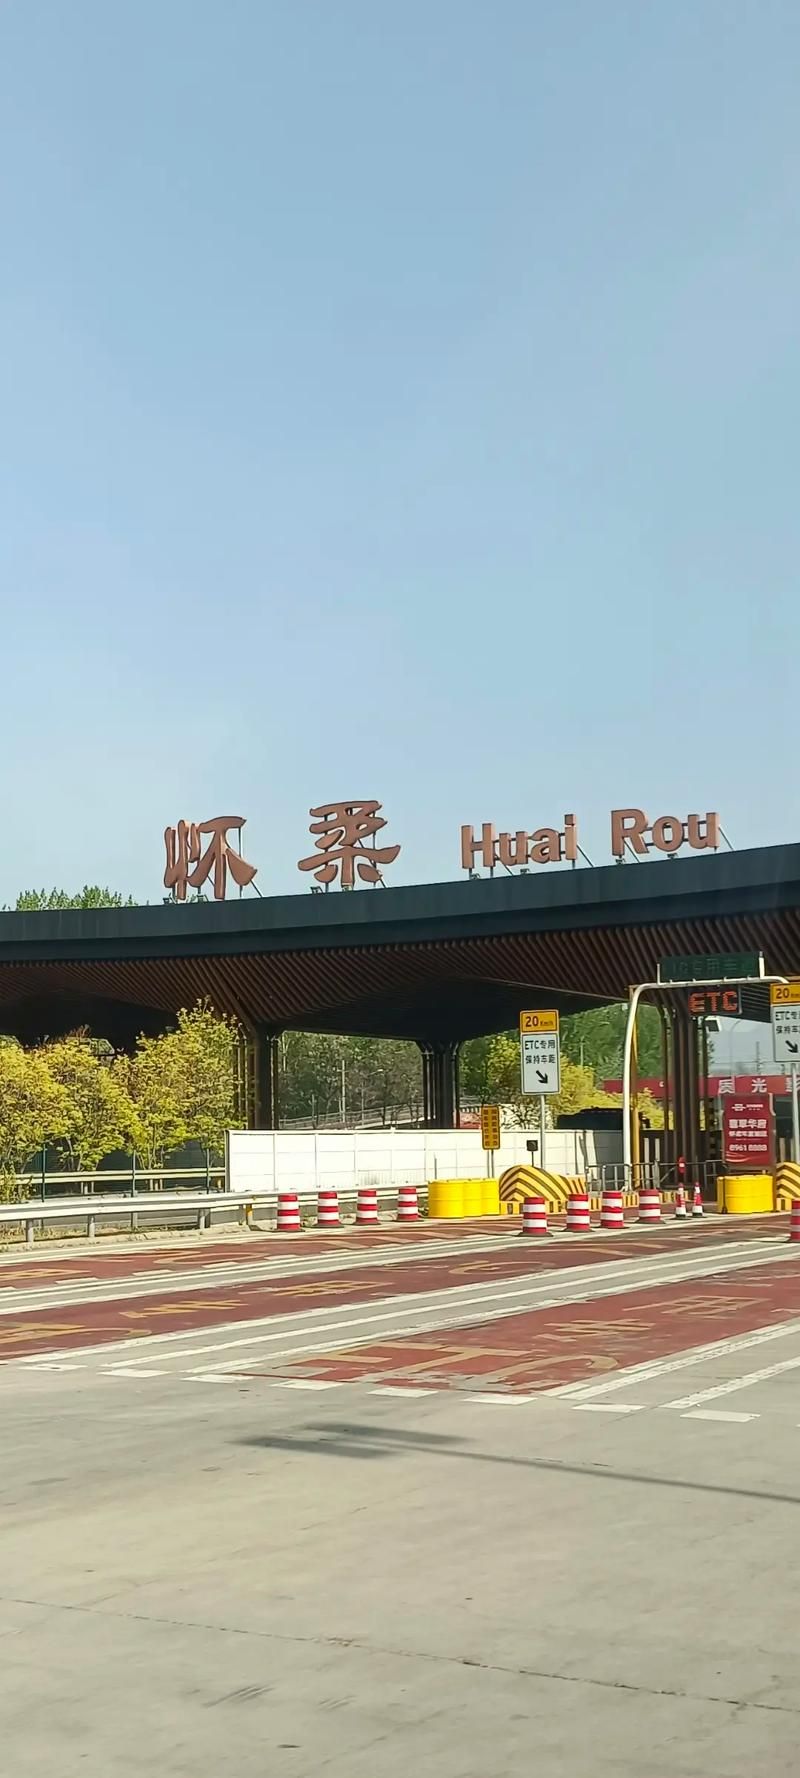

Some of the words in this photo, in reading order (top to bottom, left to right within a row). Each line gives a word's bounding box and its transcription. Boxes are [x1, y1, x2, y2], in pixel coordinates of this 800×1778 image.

[460, 813, 578, 869] Huai
[611, 808, 719, 856] Rou
[163, 800, 401, 901] 怀柔
[775, 988, 790, 999] 20
[688, 991, 738, 1013] ETC
[525, 1016, 539, 1028] 20
[524, 1039, 556, 1050] ETC专用
[525, 1054, 556, 1064] 保持车距
